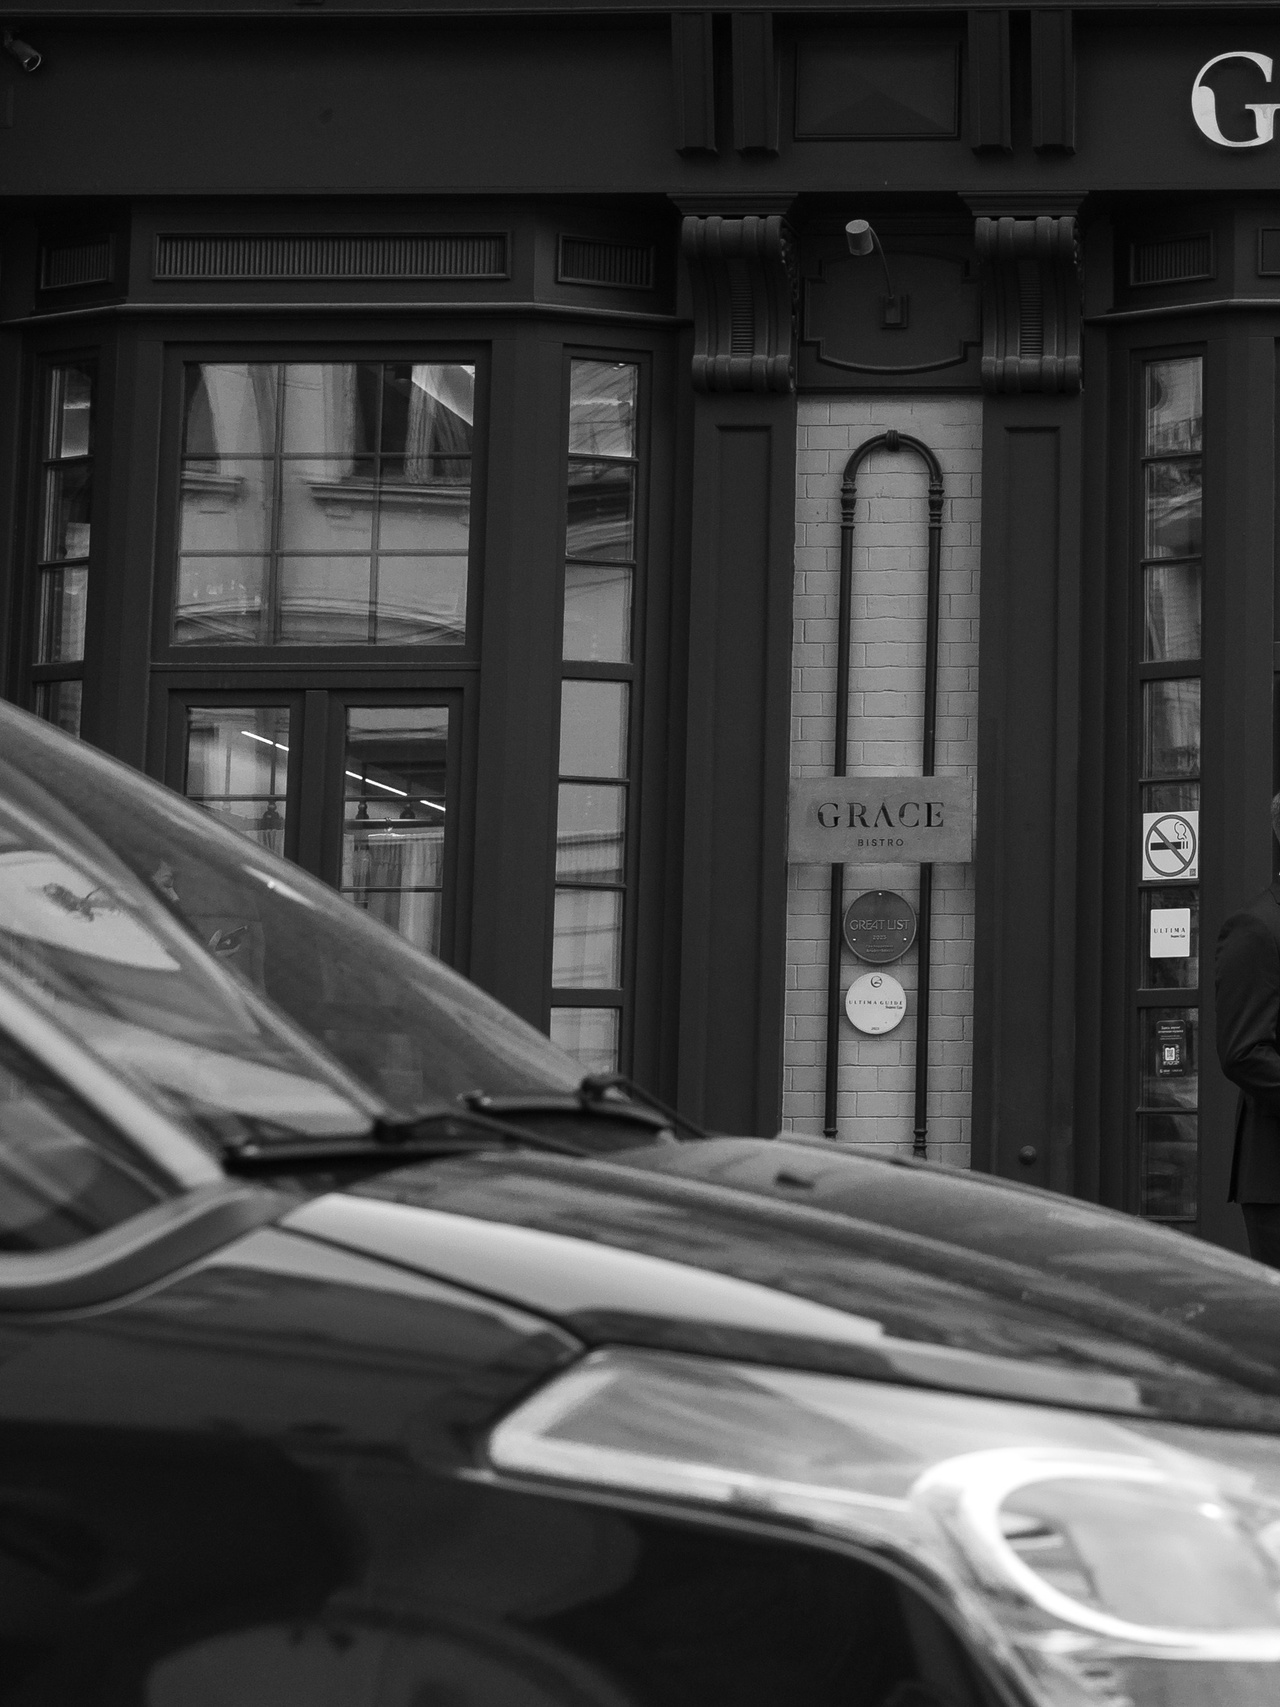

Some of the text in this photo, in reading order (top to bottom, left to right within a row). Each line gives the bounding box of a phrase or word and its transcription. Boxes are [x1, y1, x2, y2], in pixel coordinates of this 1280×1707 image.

[817, 801, 945, 828] GRACE
[857, 838, 904, 847] BISTRO
[850, 919, 910, 930] GREAT LIST
